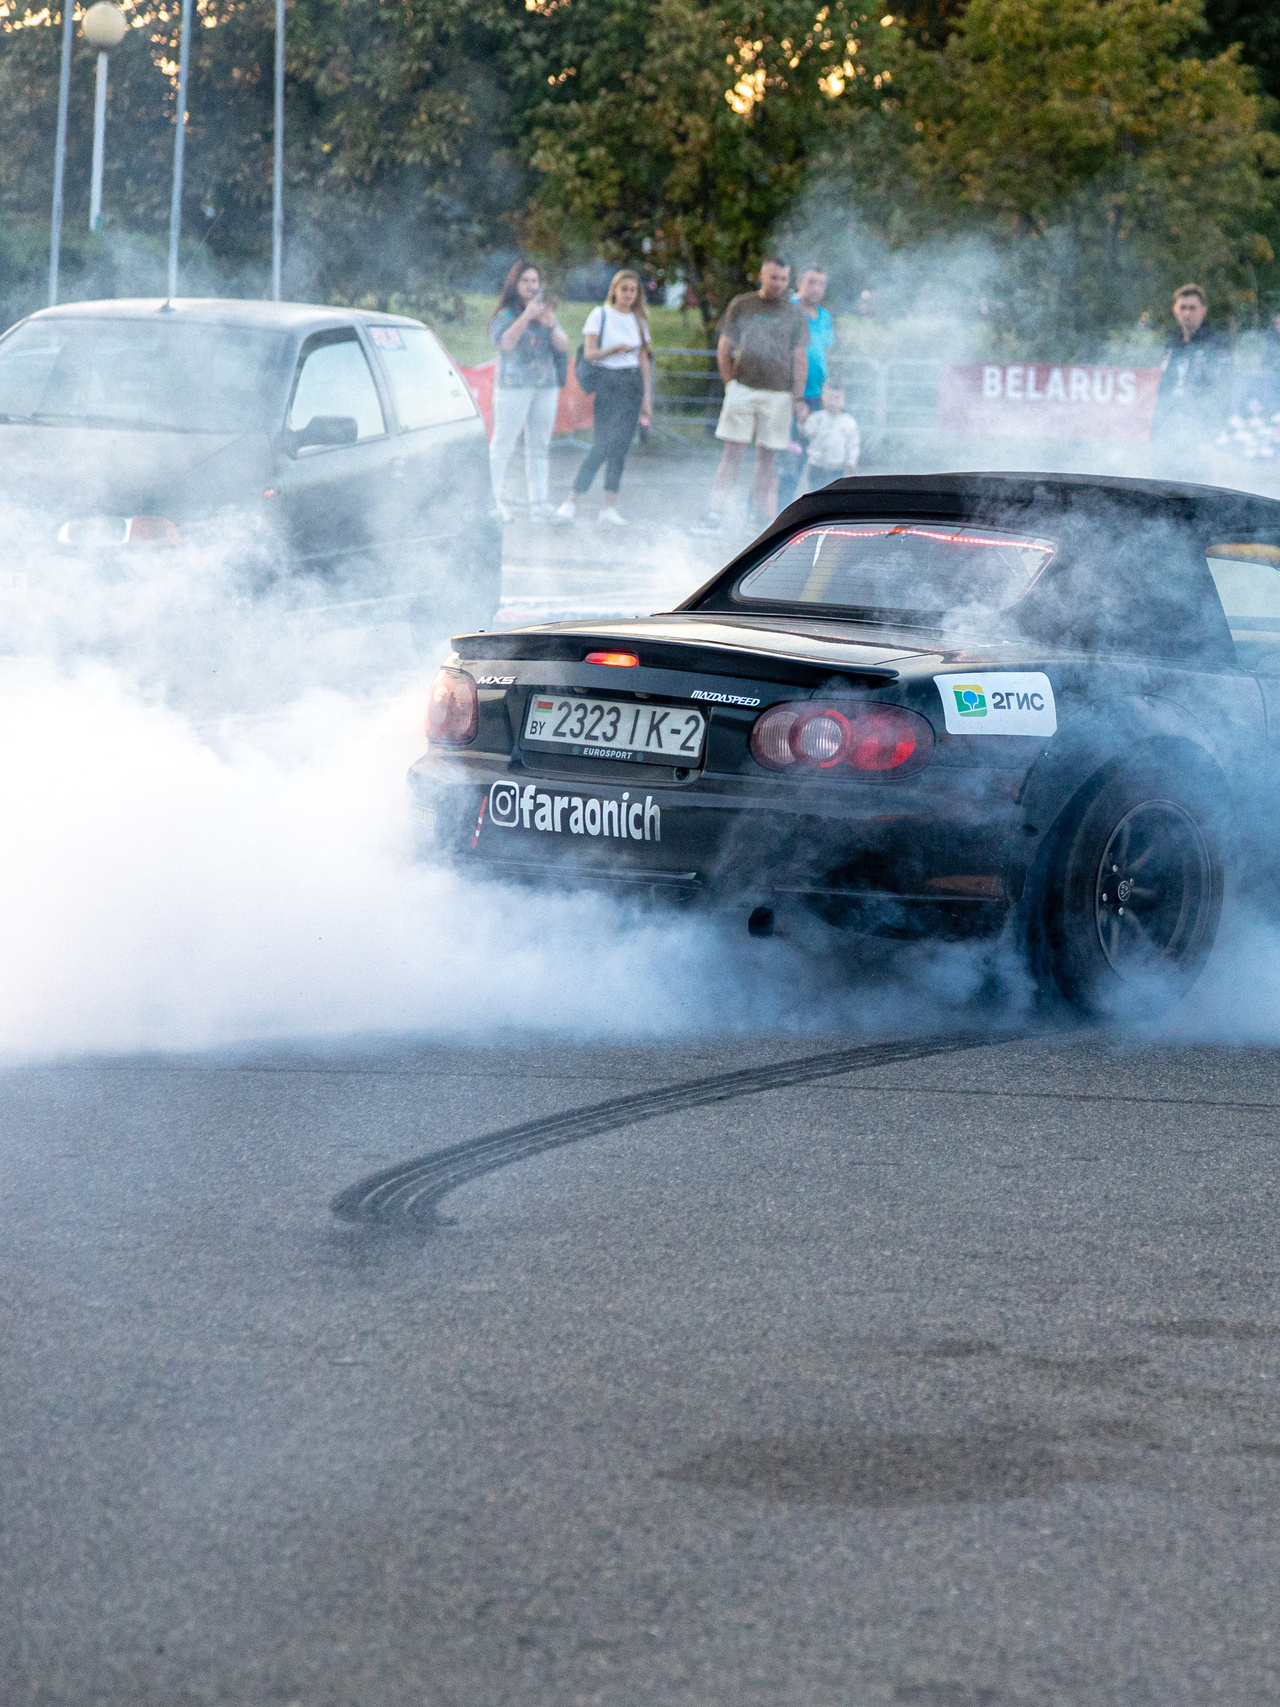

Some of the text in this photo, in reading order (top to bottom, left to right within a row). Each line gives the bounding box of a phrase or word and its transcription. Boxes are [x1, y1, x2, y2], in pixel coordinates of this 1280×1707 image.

[982, 365, 1138, 404] BELARUS
[477, 675, 517, 685] MX5
[690, 689, 761, 707] MAZDASPEED
[991, 691, 1045, 711] 2ГИС
[529, 720, 546, 736] BY
[552, 701, 622, 743] 2323
[583, 747, 633, 760] EUROSPORT
[520, 784, 661, 842] faraonich
